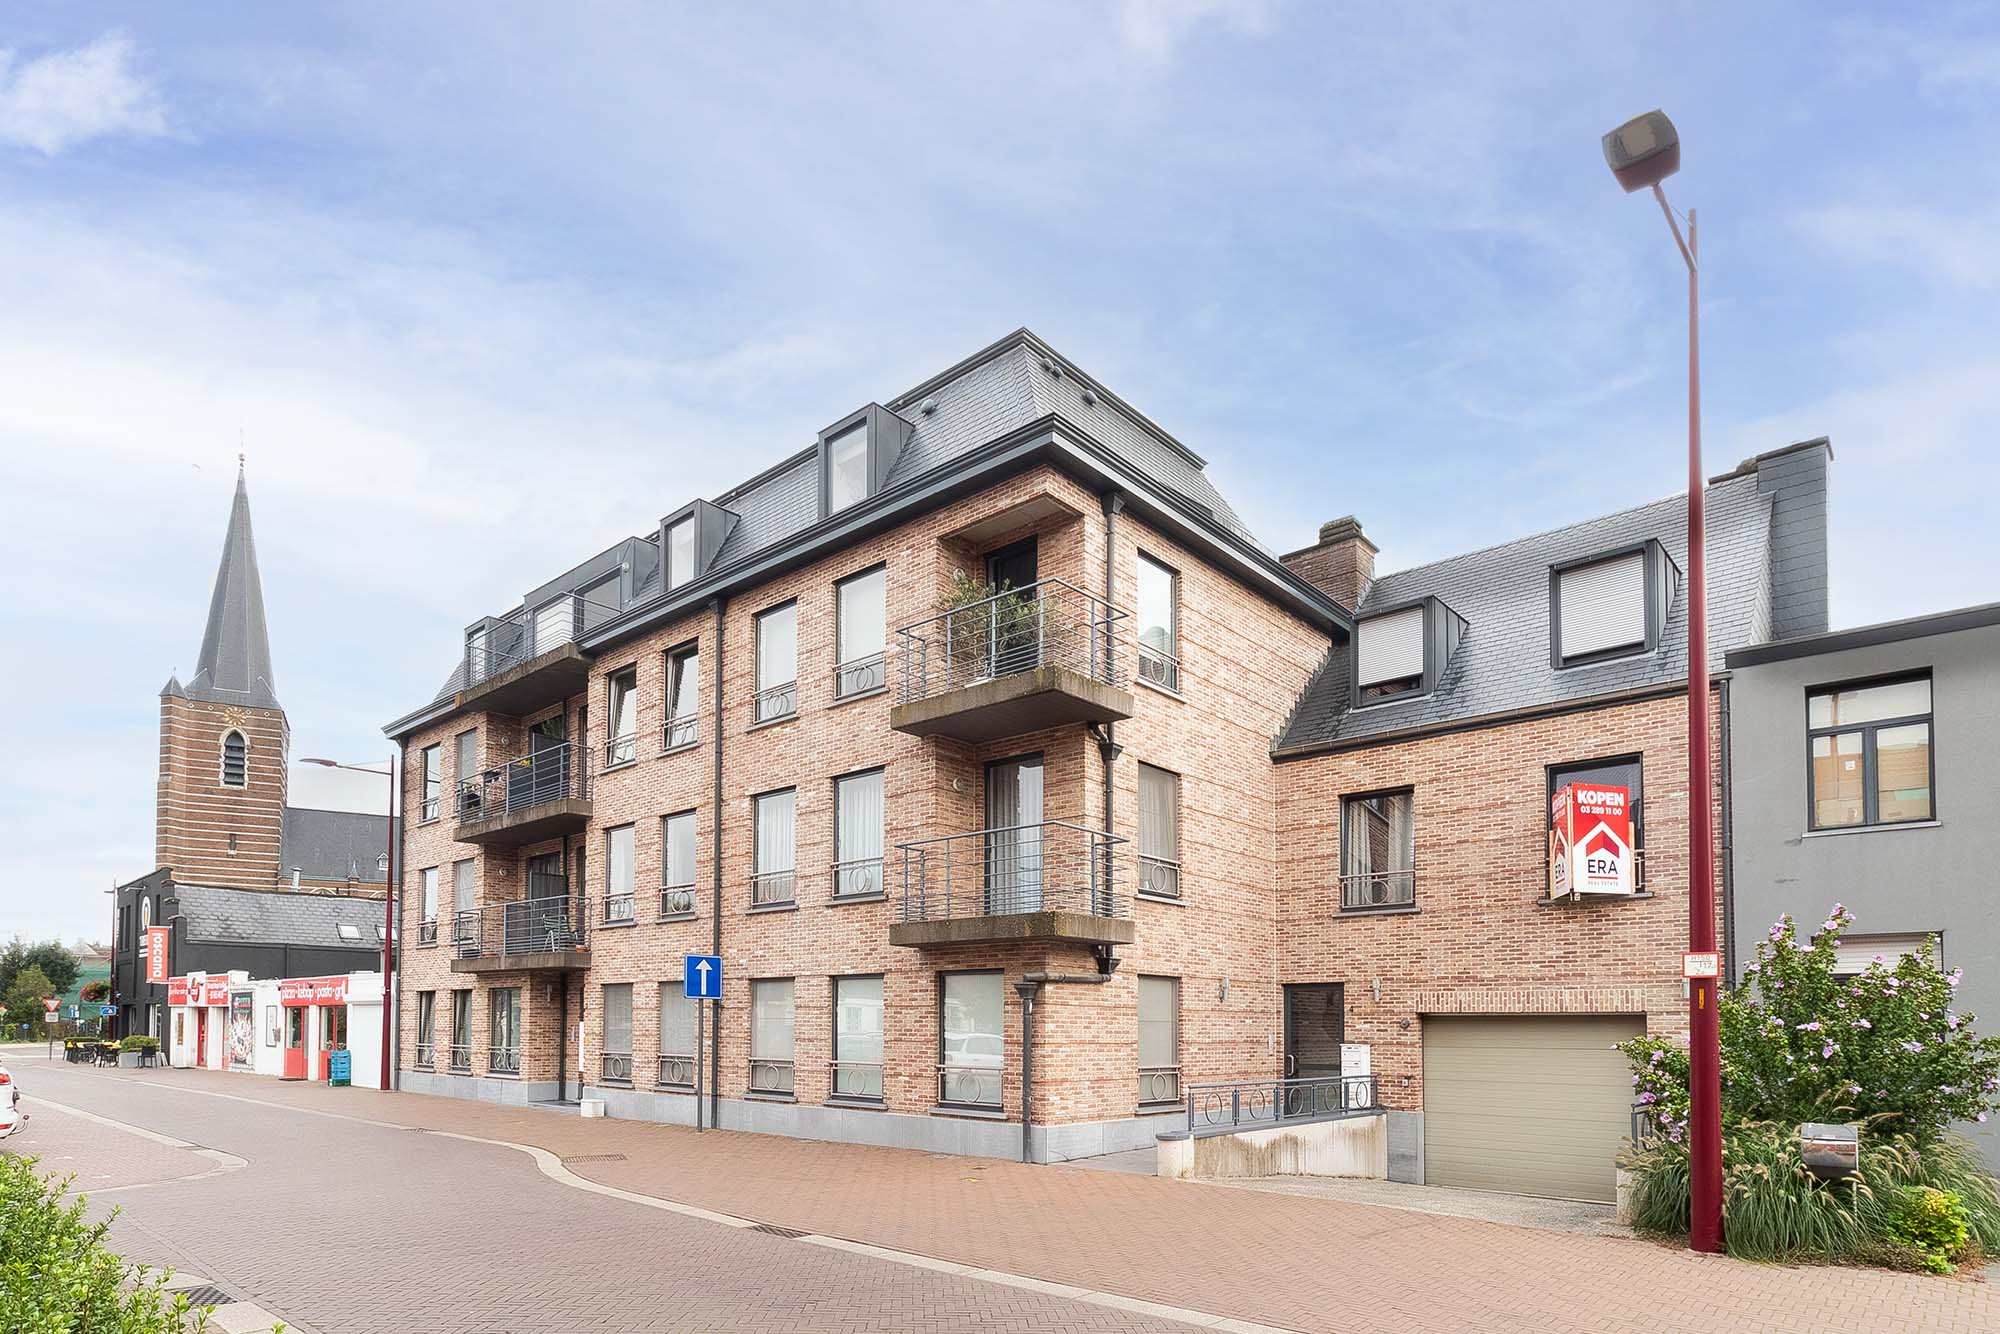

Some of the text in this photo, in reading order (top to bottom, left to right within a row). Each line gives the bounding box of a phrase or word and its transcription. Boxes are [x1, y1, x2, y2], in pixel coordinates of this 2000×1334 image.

[1577, 790, 1624, 806] KOPEN
[1581, 806, 1590, 814] 03
[1605, 807, 1612, 815] 11
[1612, 807, 1623, 816] 00
[1555, 861, 1565, 879] ERA
[1587, 859, 1618, 874] ERA
